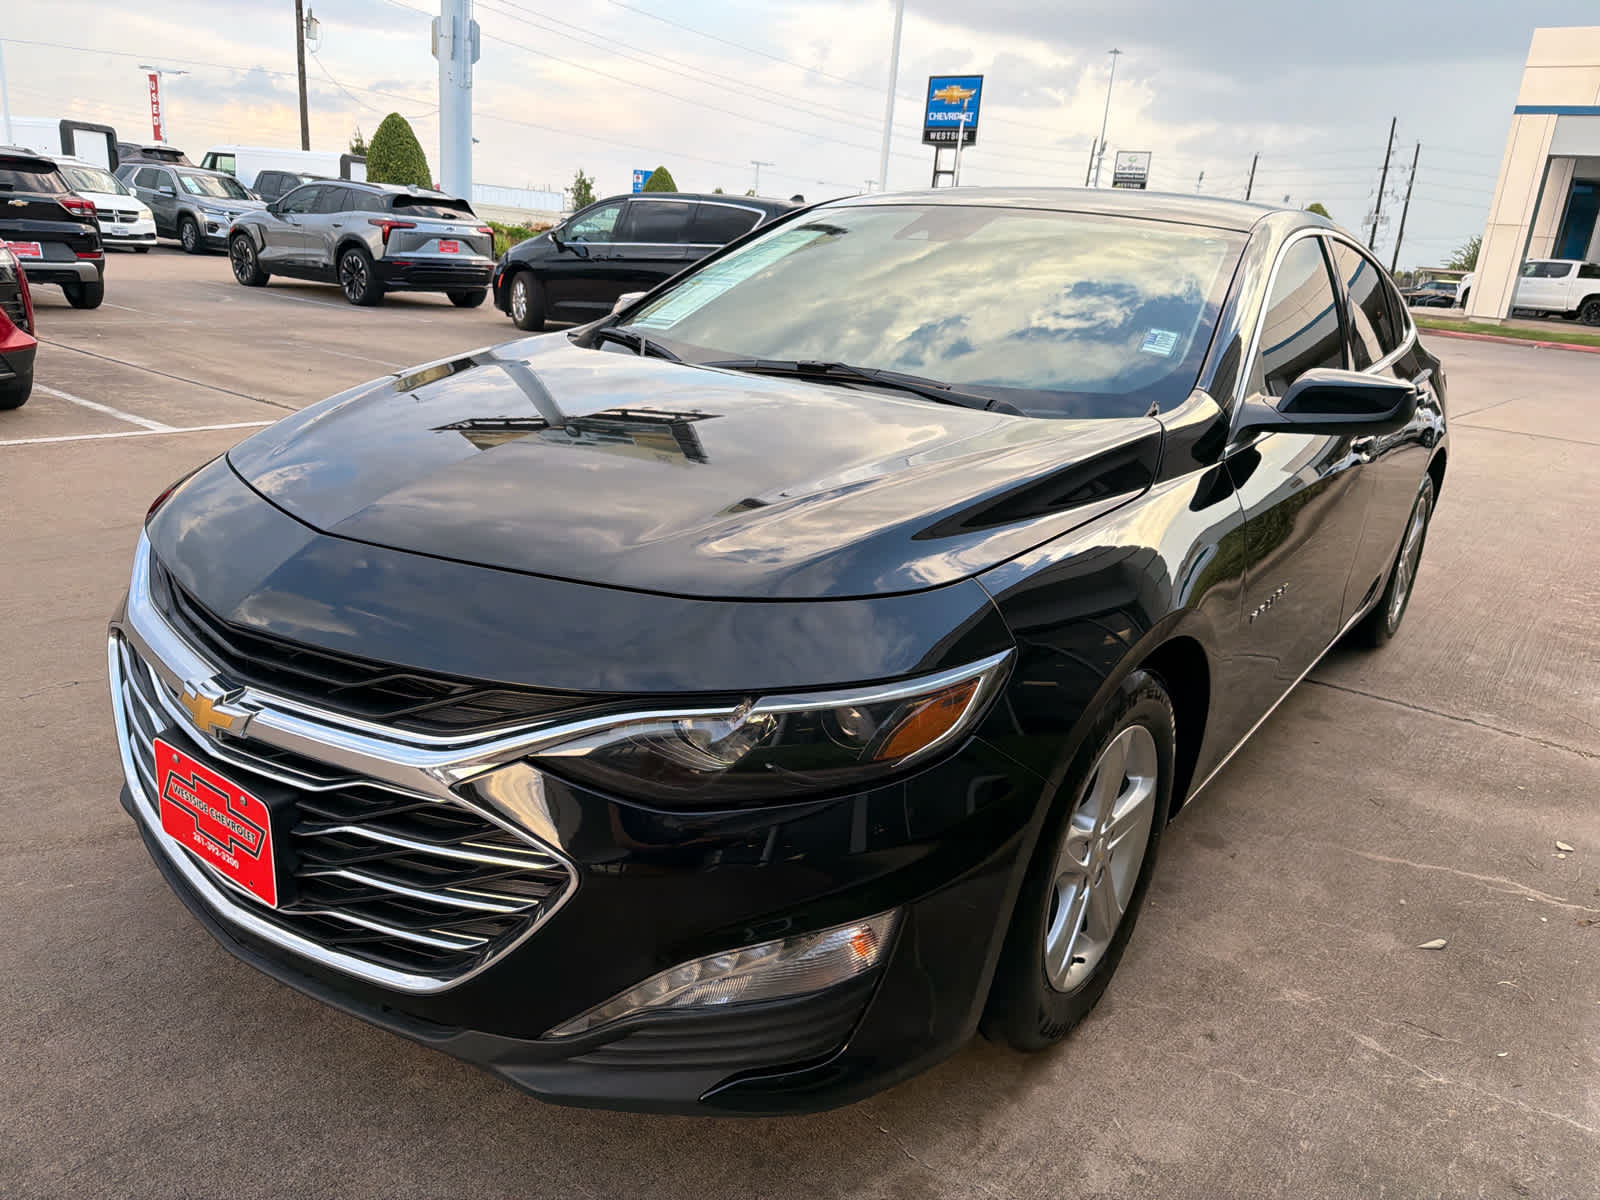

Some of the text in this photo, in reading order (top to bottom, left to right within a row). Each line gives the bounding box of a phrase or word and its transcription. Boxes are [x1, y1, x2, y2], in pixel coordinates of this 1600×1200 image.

[150, 81, 159, 126] USED
[928, 112, 974, 122] CHEVROET
[930, 132, 968, 140] WESTSIE
[172, 783, 255, 844] WESTSIDE CHEVROLET
